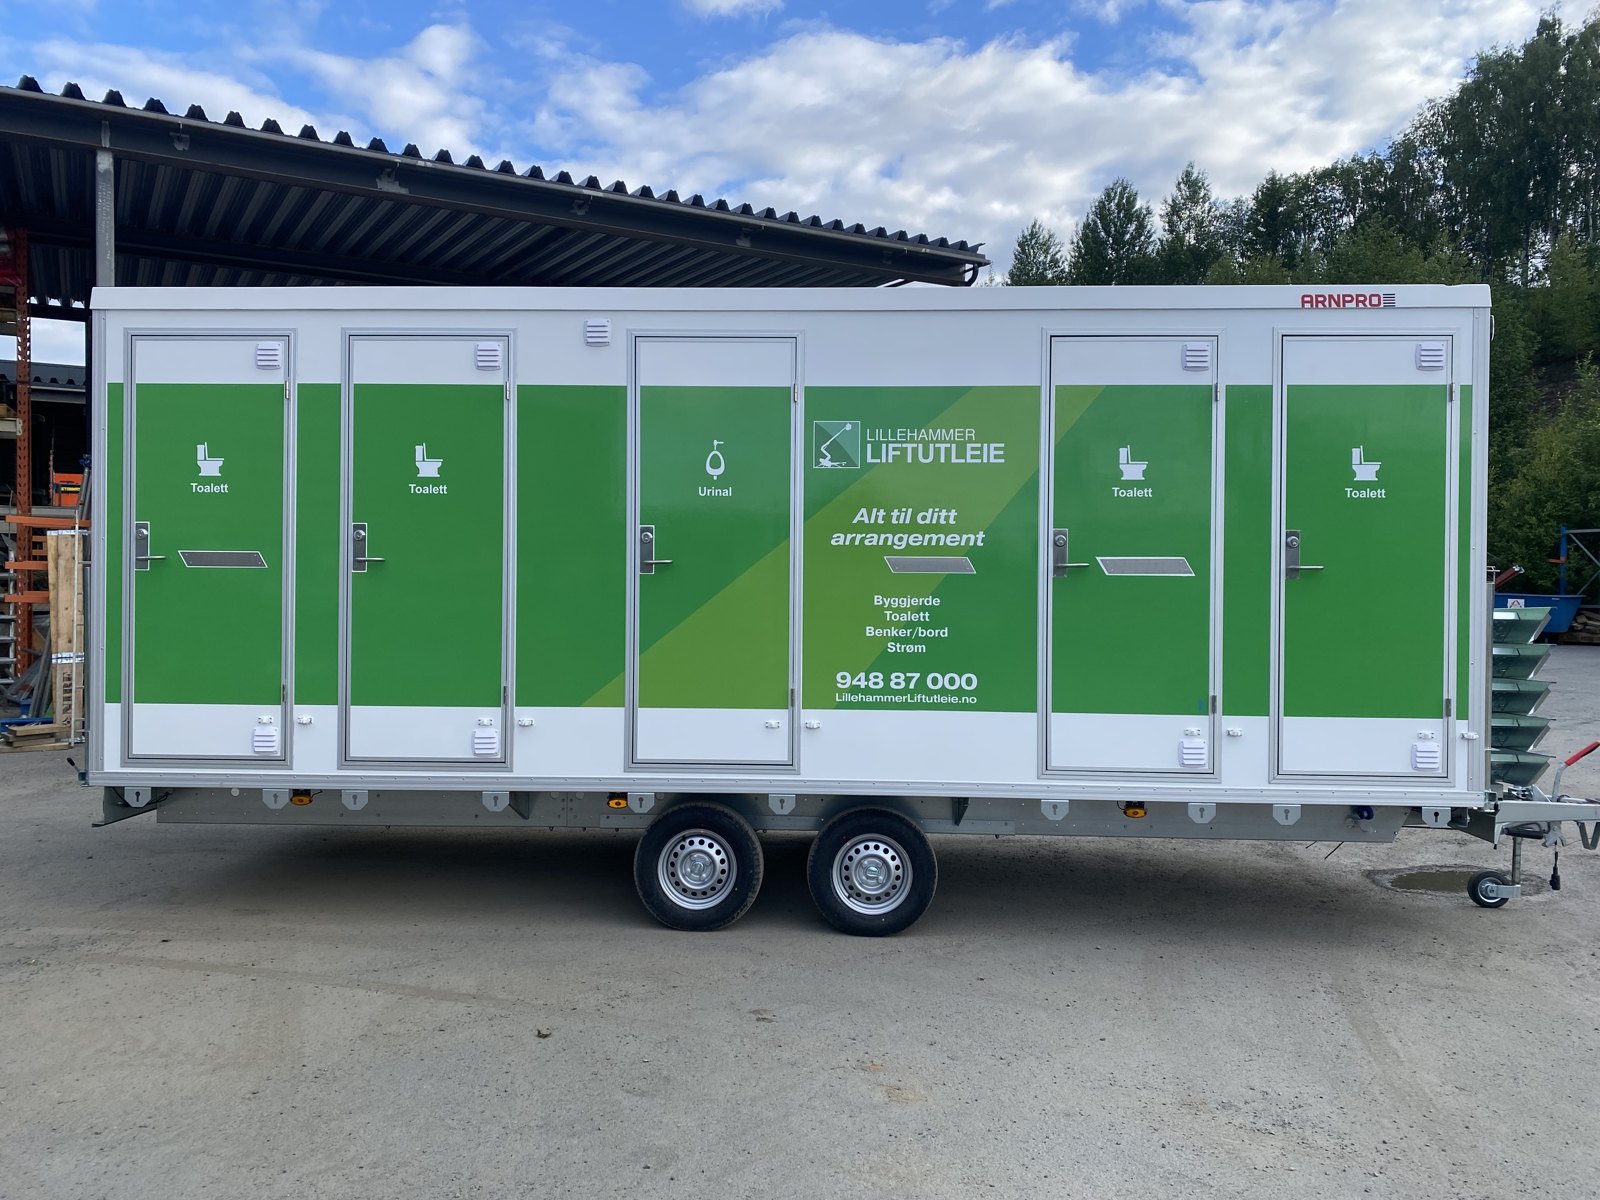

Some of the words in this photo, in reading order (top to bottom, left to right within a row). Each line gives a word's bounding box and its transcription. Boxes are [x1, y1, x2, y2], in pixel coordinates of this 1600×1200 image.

[1301, 294, 1381, 308] ARNPRO
[866, 428, 976, 441] LILLEHAMMER
[866, 443, 1005, 464] LIFTUTLEIE
[190, 482, 229, 493] Toalett
[408, 483, 448, 495] Toalett
[698, 486, 732, 497] Urinal
[1111, 487, 1153, 498] Toalett
[1344, 487, 1386, 499] Toalett
[852, 507, 887, 525] Alt
[890, 507, 913, 525] til
[916, 507, 958, 525] ditt
[830, 530, 986, 550] arrangement
[873, 594, 941, 608] Byggjerde
[883, 610, 930, 622] Toalett
[865, 626, 949, 639] Benker/bord
[887, 641, 926, 653] Strøm
[835, 671, 885, 690] 948
[889, 672, 921, 690] 87
[926, 672, 978, 691] 000
[835, 692, 978, 704] LillehammerLiftutleie.no
